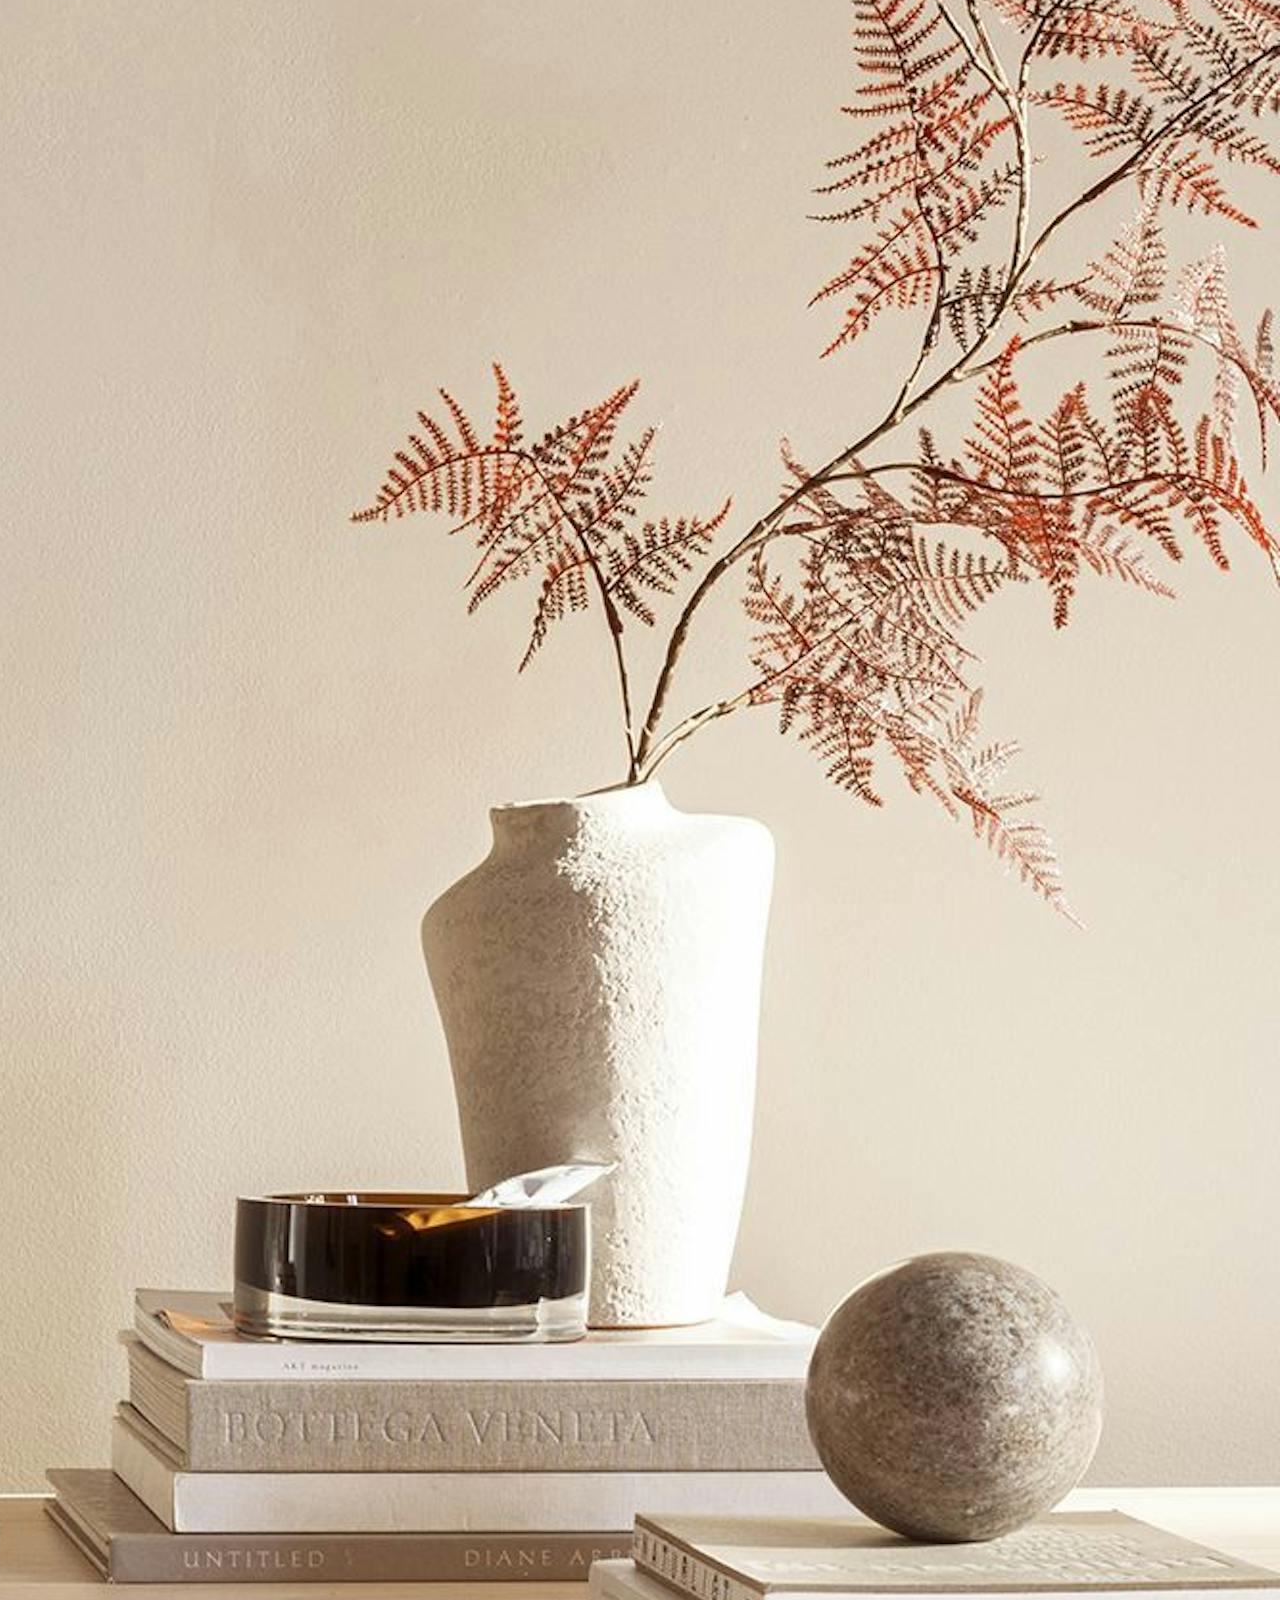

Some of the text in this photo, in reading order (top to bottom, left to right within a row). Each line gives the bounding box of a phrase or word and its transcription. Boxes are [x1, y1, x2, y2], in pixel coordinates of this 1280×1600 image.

[222, 1411, 658, 1445] BOTTEGA VENETA
[182, 1550, 326, 1569] UNTITLED
[464, 1549, 553, 1568] DIANE
